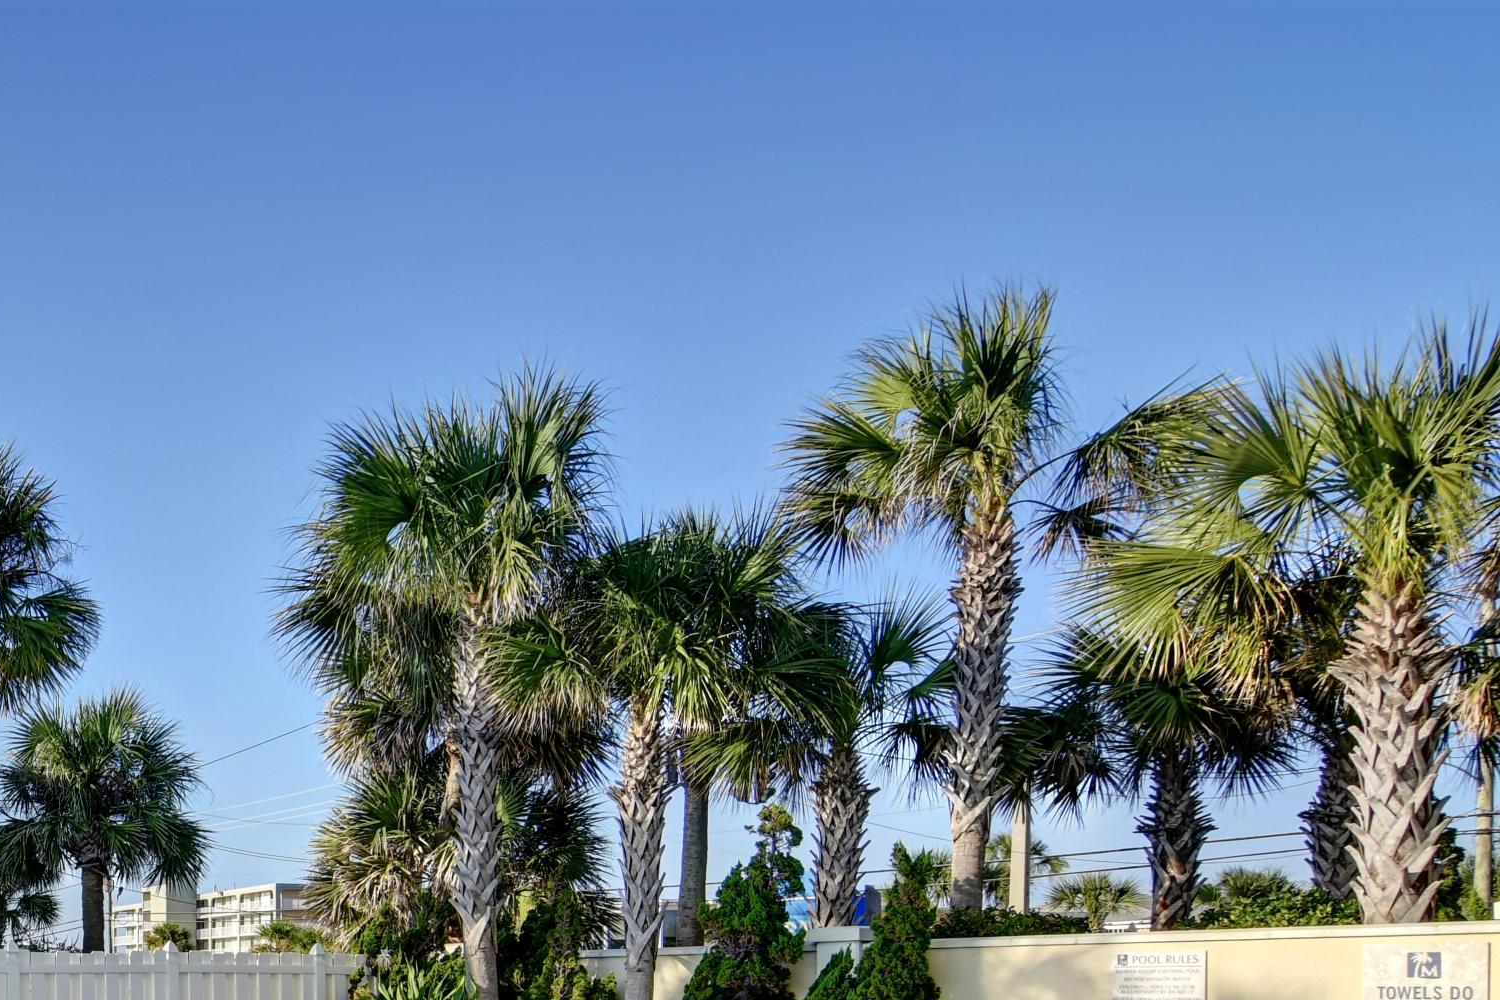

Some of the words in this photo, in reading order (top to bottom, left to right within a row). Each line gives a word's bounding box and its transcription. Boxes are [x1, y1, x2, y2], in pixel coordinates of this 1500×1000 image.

[1132, 955, 1162, 965] POOL
[1166, 954, 1199, 964] RULES
[1377, 986, 1443, 1000] TOWELS
[1450, 986, 1474, 1000] DO
